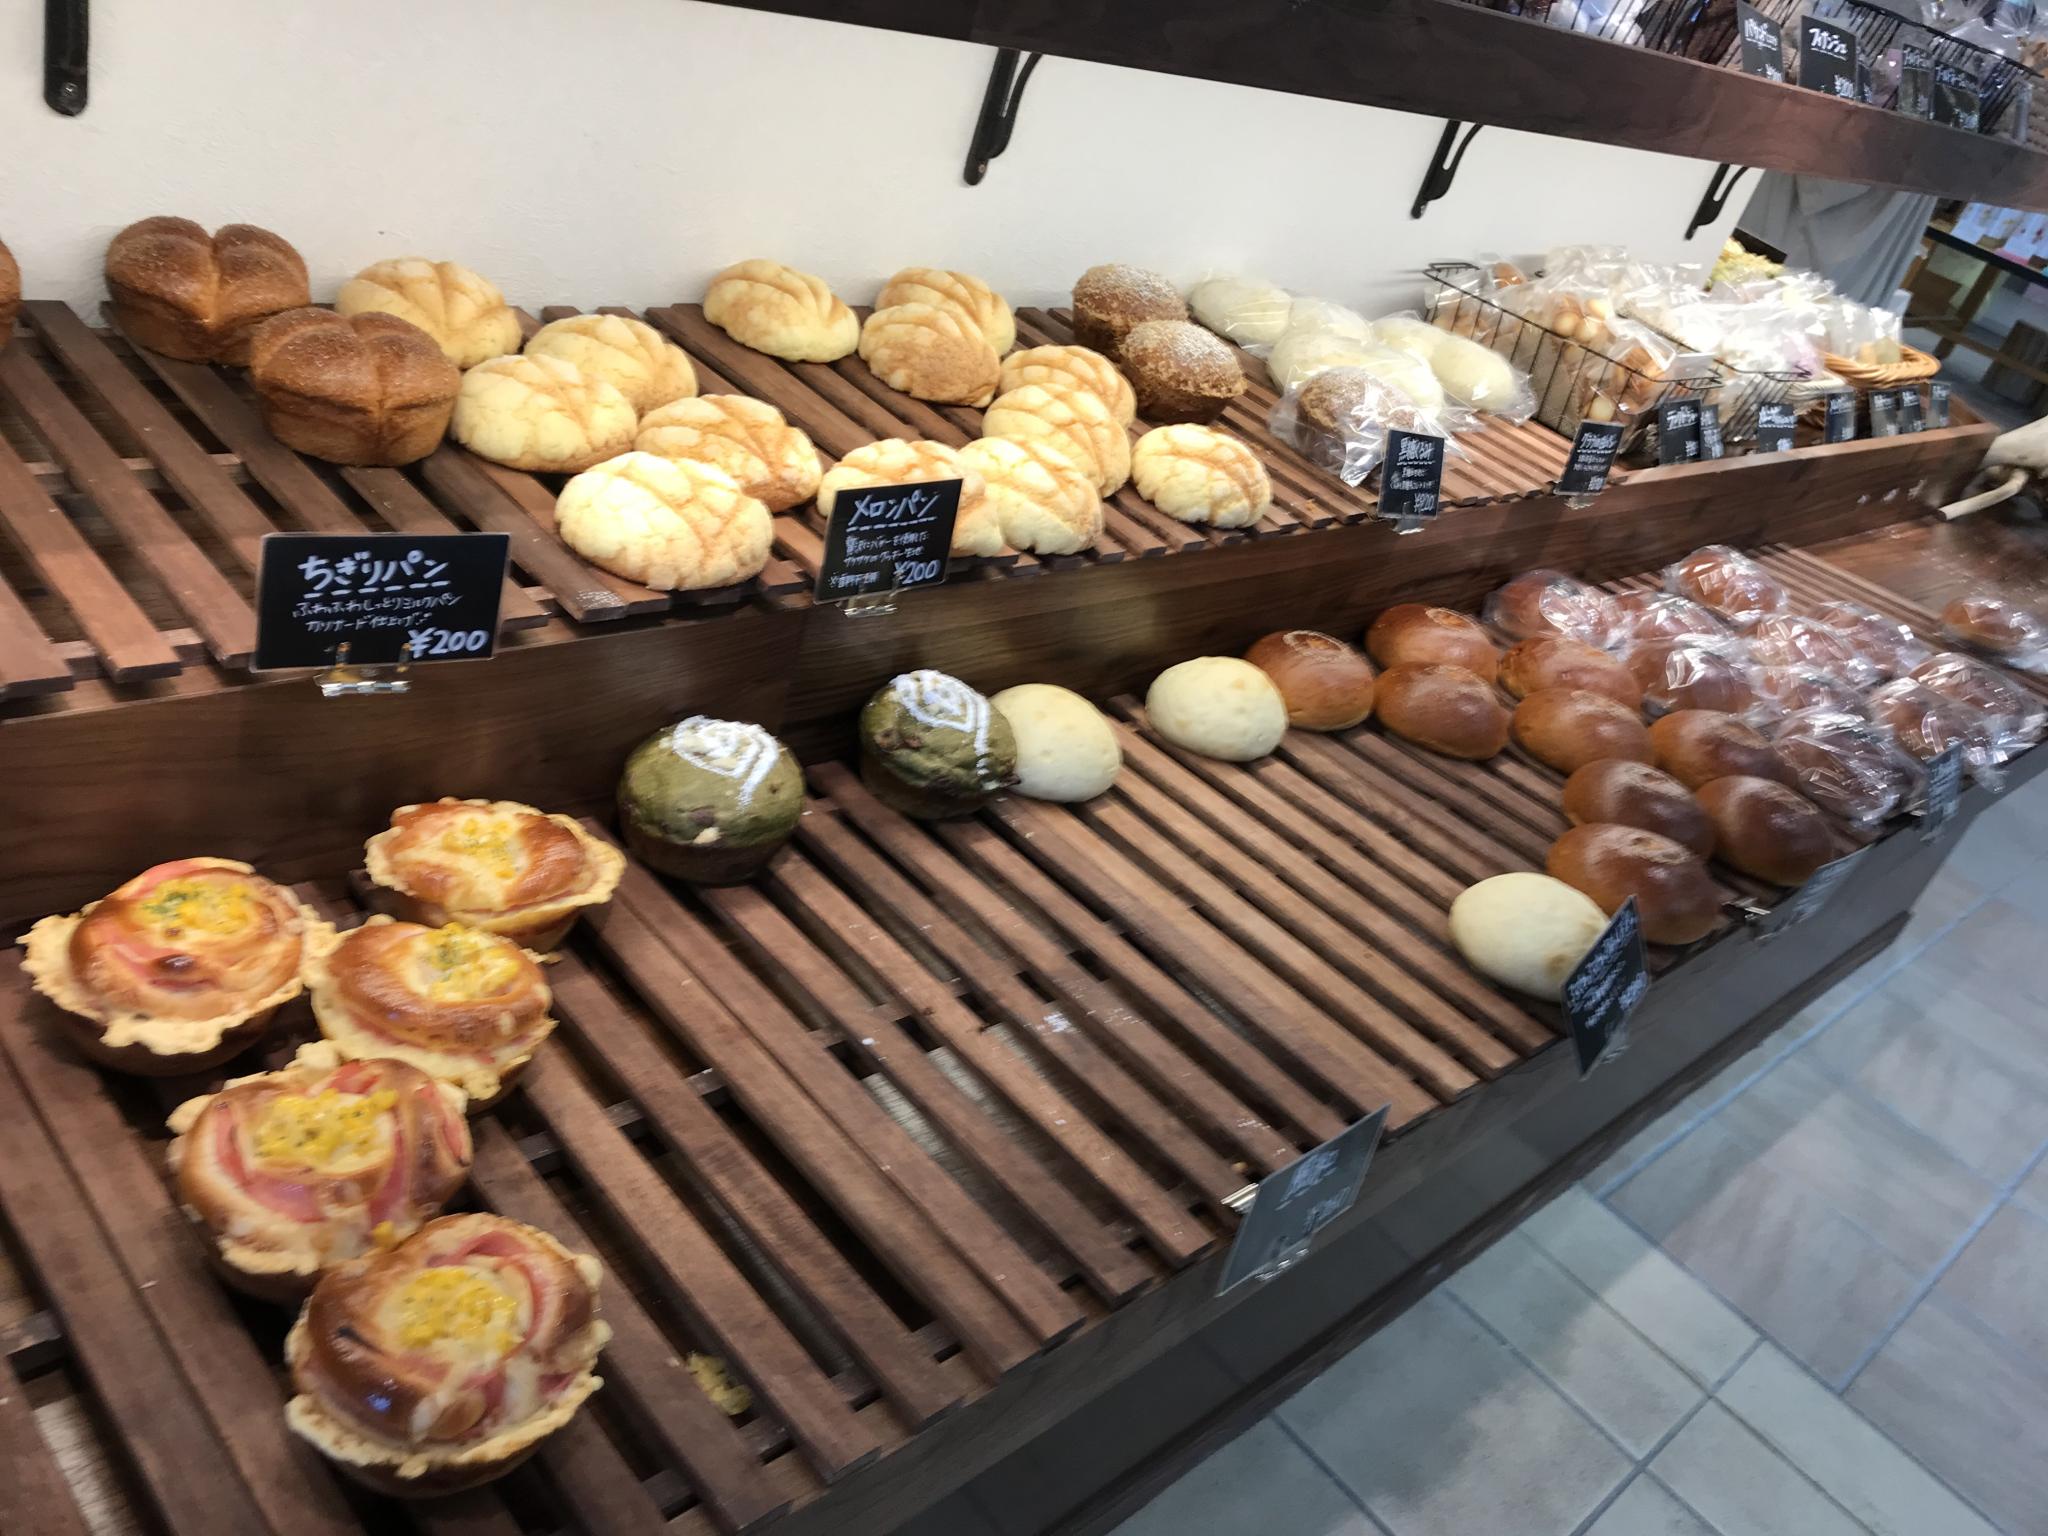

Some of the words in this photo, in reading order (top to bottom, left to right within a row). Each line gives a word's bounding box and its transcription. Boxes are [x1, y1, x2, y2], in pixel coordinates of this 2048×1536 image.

[847, 489, 942, 527] メロンパン
[297, 549, 449, 590] ちぎりパン
[893, 559, 941, 585] ¥200
[407, 626, 489, 659] ¥200
